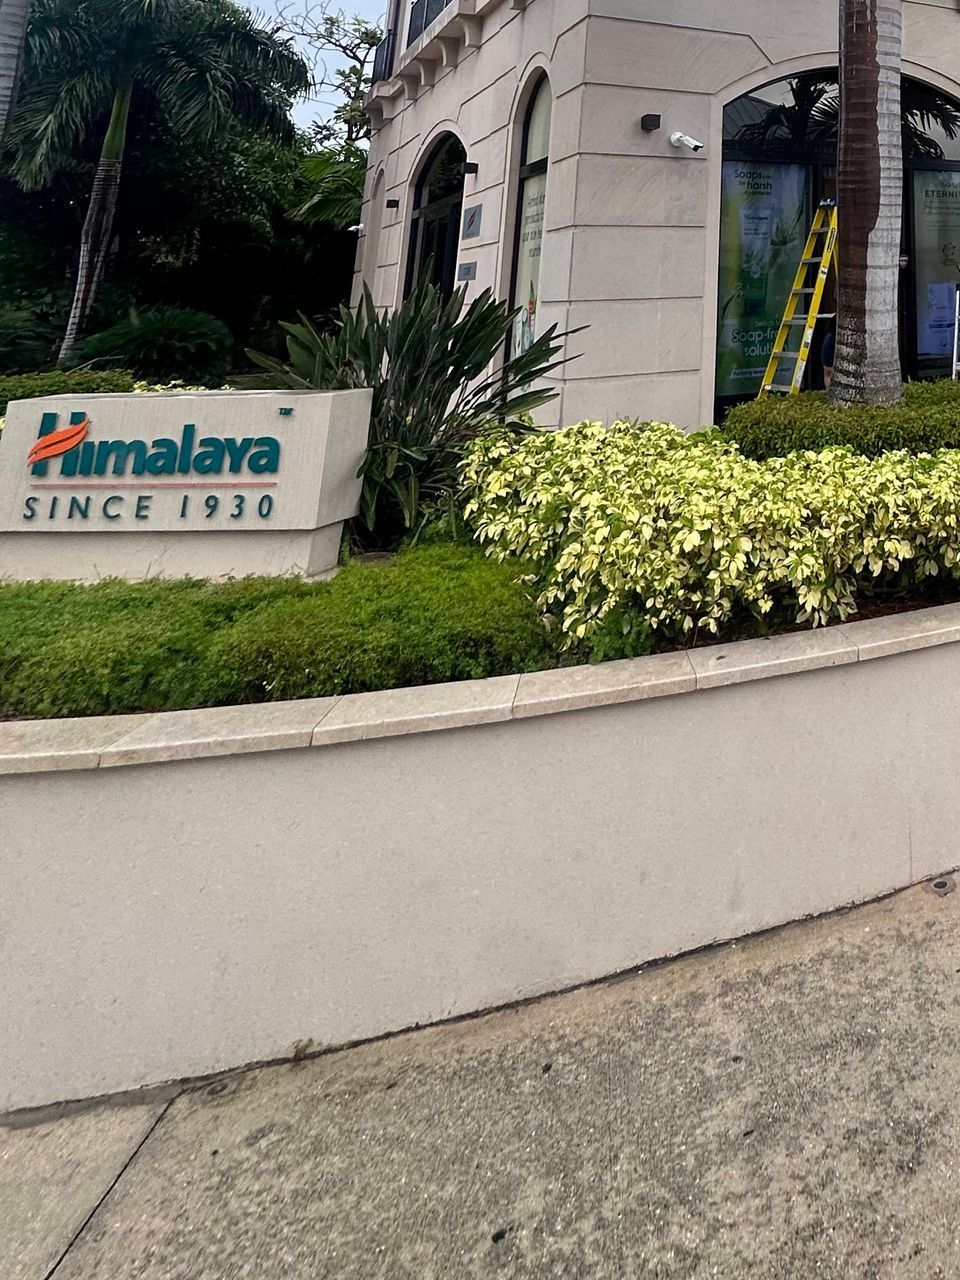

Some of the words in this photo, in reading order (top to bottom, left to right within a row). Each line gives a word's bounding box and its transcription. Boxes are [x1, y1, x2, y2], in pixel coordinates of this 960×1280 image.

[734, 168, 762, 181] Soaps
[747, 180, 772, 190] harsh
[731, 328, 778, 344] Soap-fr
[28, 411, 281, 476] Himalaya
[23, 495, 153, 520] SINCE
[180, 494, 274, 519] 1930
